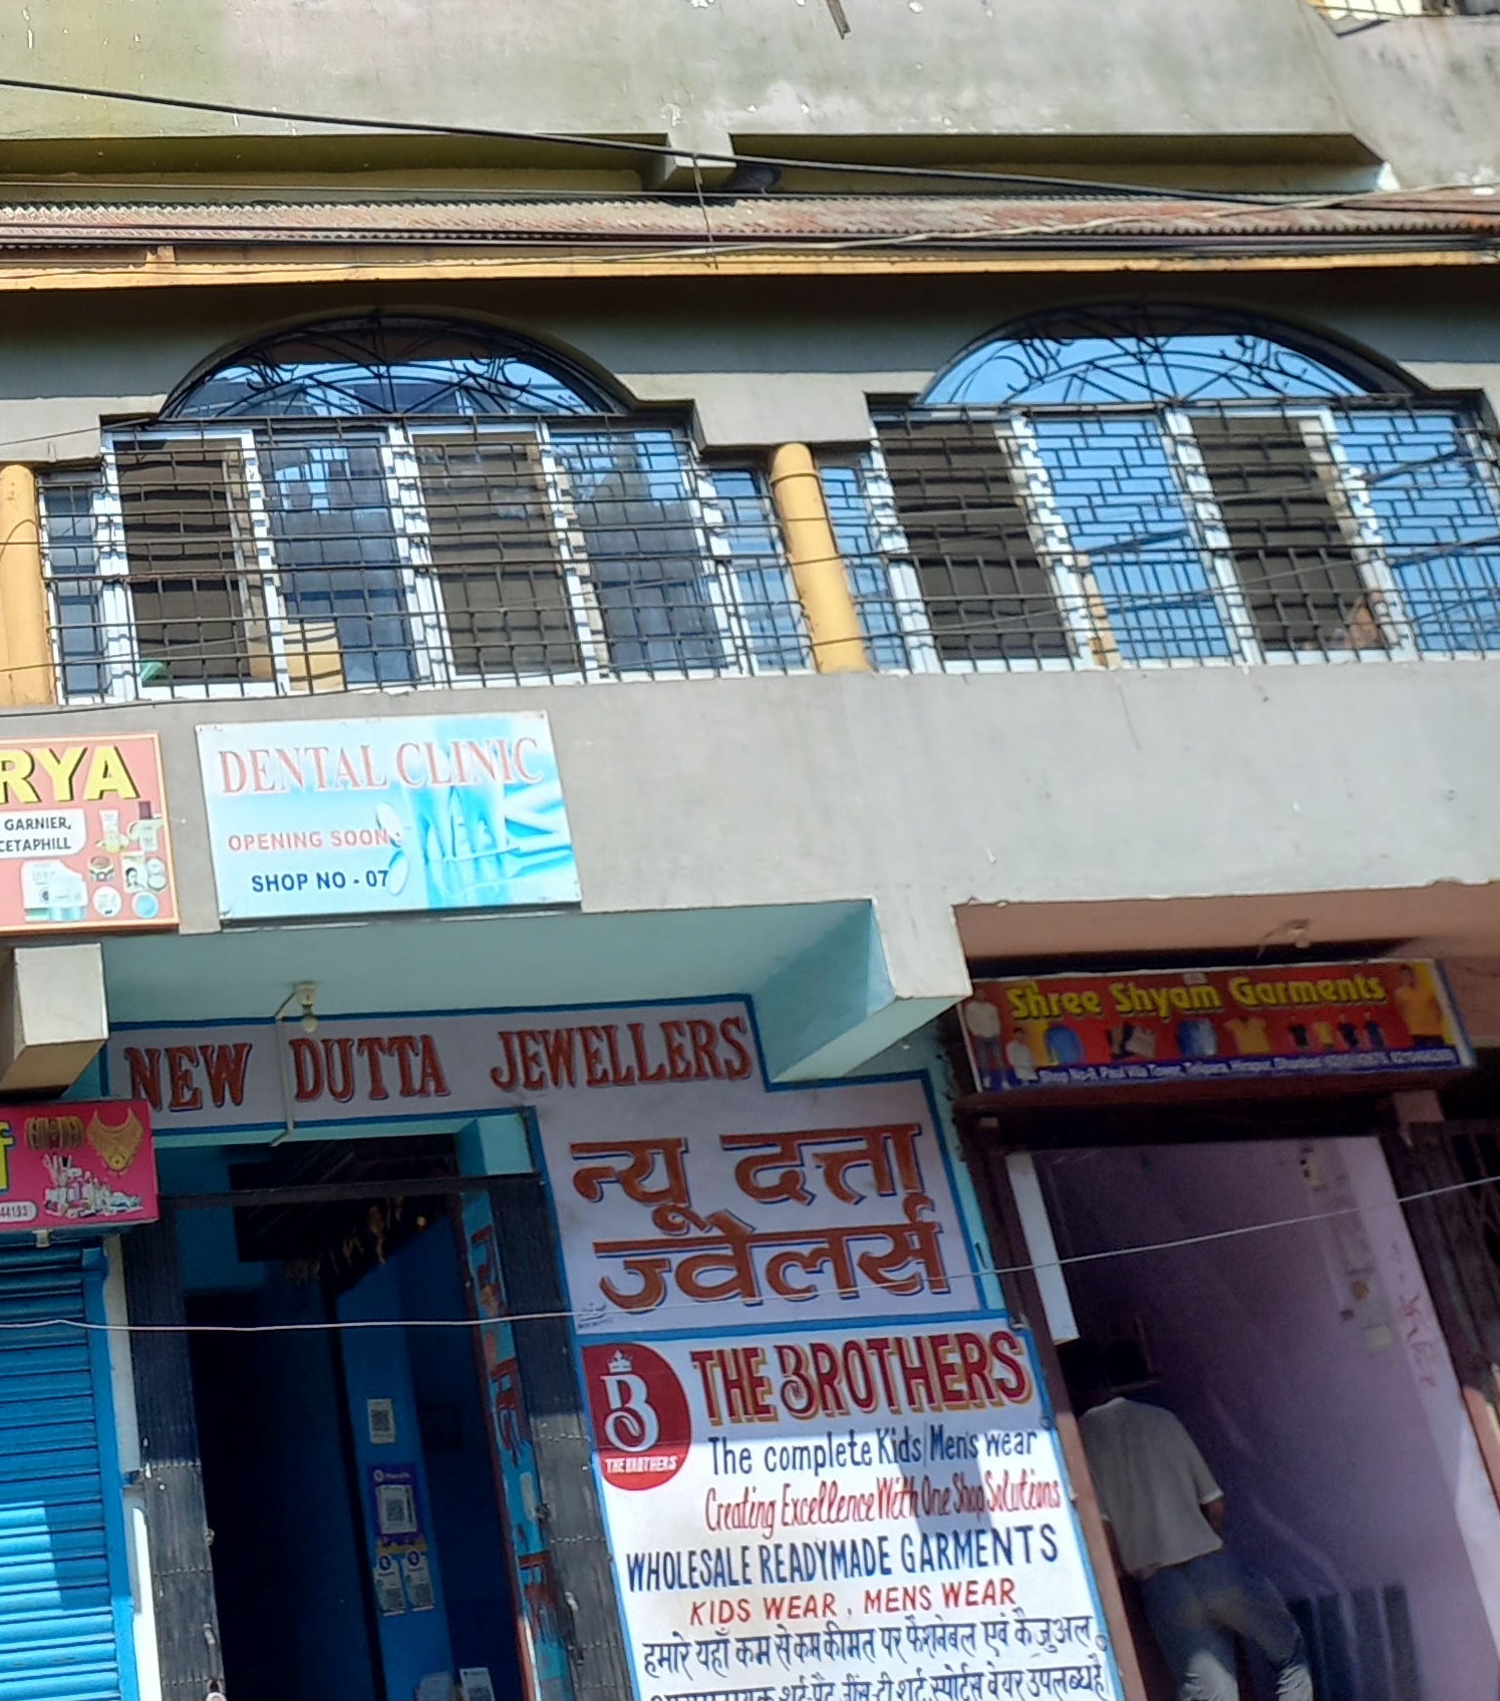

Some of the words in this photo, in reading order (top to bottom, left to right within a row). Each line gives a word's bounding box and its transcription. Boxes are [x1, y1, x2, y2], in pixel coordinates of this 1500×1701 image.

[217, 745, 389, 796] DENTAL
[396, 736, 545, 789] CLINIC
[4, 816, 72, 831] GARNIER,
[228, 830, 323, 851] OPENING
[251, 872, 308, 893] SHOP
[316, 871, 346, 890] NO
[366, 870, 389, 887] 07
[1006, 982, 1101, 1020] Shree
[1109, 982, 1223, 1022] Shyam
[1229, 975, 1387, 1006] Garments
[124, 1042, 252, 1112] NEW
[288, 1034, 452, 1103] DUTTA
[489, 1015, 754, 1093] JEWELLERS
[570, 1136, 709, 1236] न्यू
[719, 1123, 921, 1205] दत्ता
[593, 1193, 951, 1313] ज्वेलर्स
[690, 1345, 779, 1426] THE
[773, 1330, 1033, 1420] BROTHERS
[708, 1436, 752, 1475] The
[764, 1428, 872, 1477] complete
[984, 1431, 1038, 1457] wear
[705, 1486, 776, 1540] Creating
[782, 1479, 875, 1527] Excellence
[876, 1475, 920, 1520] With
[921, 1474, 951, 1517] One
[984, 1467, 1062, 1513] Solutions
[626, 1545, 753, 1592] WHOLESALE
[758, 1535, 893, 1585] READYMADE
[900, 1523, 1058, 1574] GARMENTS
[689, 1598, 751, 1626] KIDS
[763, 1592, 838, 1620] WEAR
[864, 1584, 932, 1614] MENS
[941, 1577, 1017, 1609] WEAR
[642, 1630, 694, 1681] हमारे
[735, 1635, 772, 1667] कम
[879, 1626, 908, 1664] पर
